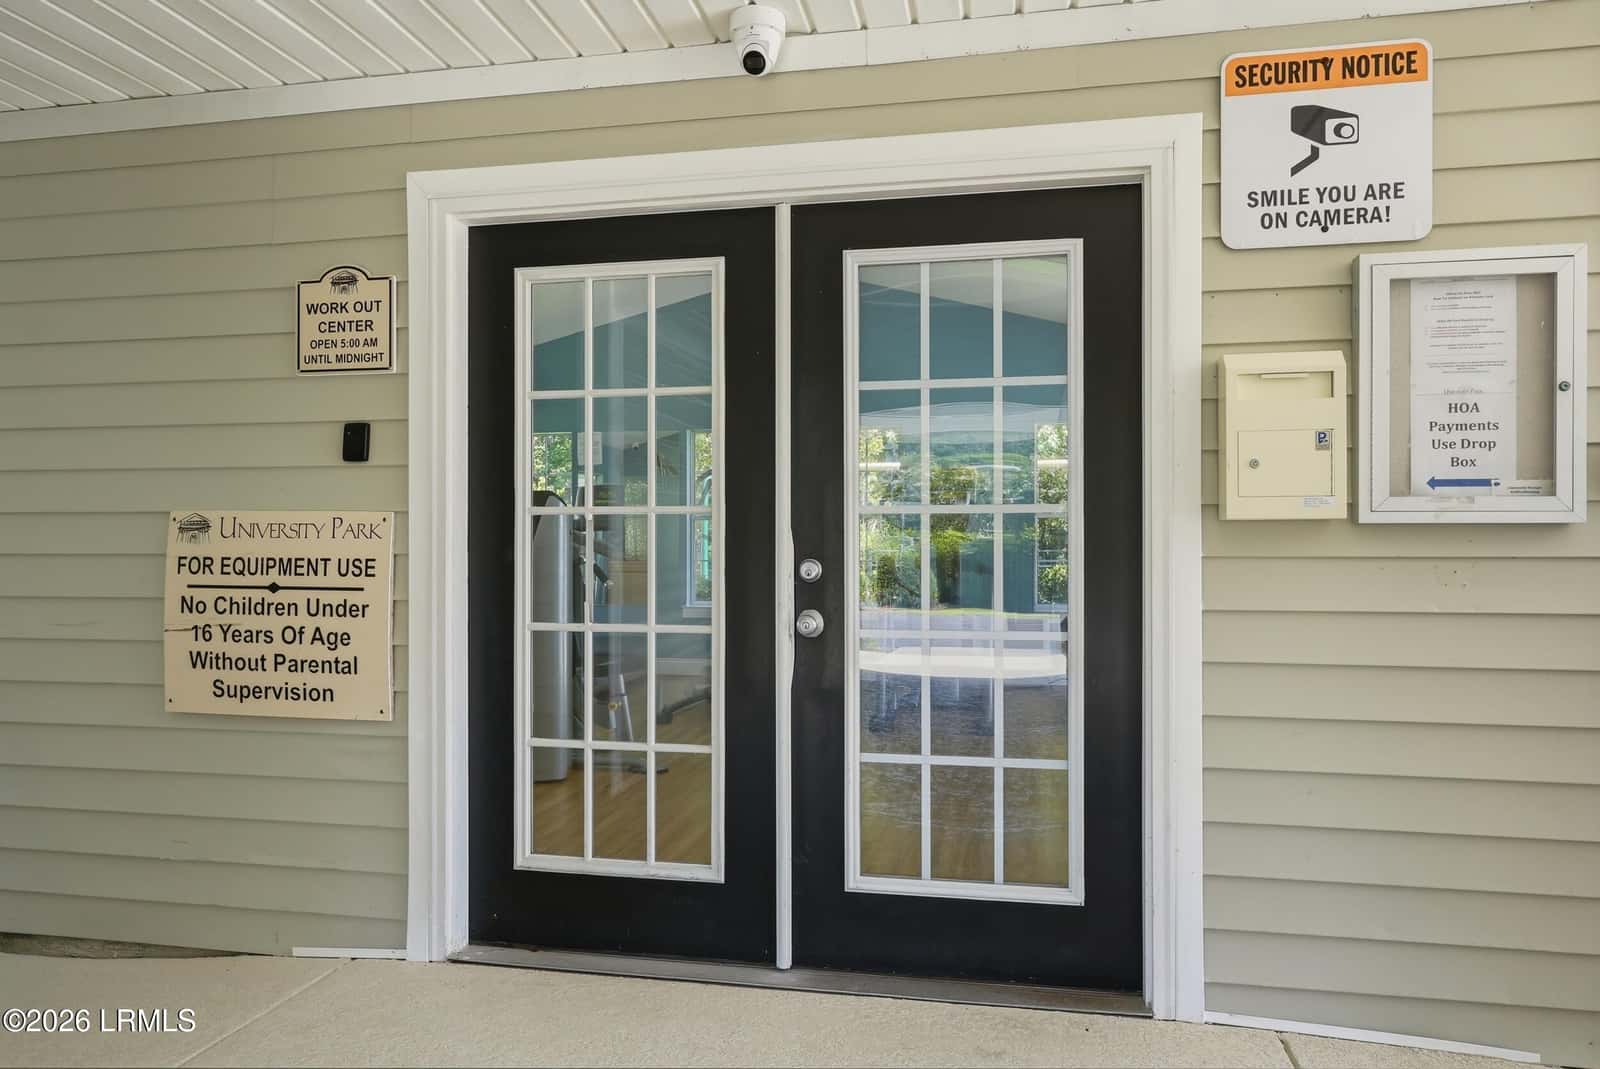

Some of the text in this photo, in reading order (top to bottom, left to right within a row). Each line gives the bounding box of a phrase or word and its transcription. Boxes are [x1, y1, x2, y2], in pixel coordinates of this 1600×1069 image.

[1234, 50, 1418, 88] SECURITY NOTICE
[1247, 182, 1405, 208] SMILE YOU ARE
[1260, 205, 1391, 230] ON CAMERA!
[306, 300, 382, 315] WORK OUT
[318, 320, 374, 334] CENTER
[310, 337, 378, 350] OPEN 5:00 AM
[304, 352, 385, 365] UNTIL MIDNIGHT
[1447, 402, 1480, 414] HOA
[1429, 420, 1499, 434] Payments
[1431, 438, 1497, 452] Use Drop
[1450, 456, 1477, 468] Box
[177, 556, 377, 577] FOR EQUIPMENT USE
[180, 595, 370, 618] No Children Under
[191, 623, 352, 651] 16 Years Of Age
[189, 650, 359, 675] Without Parental
[212, 679, 335, 703] Supervision
